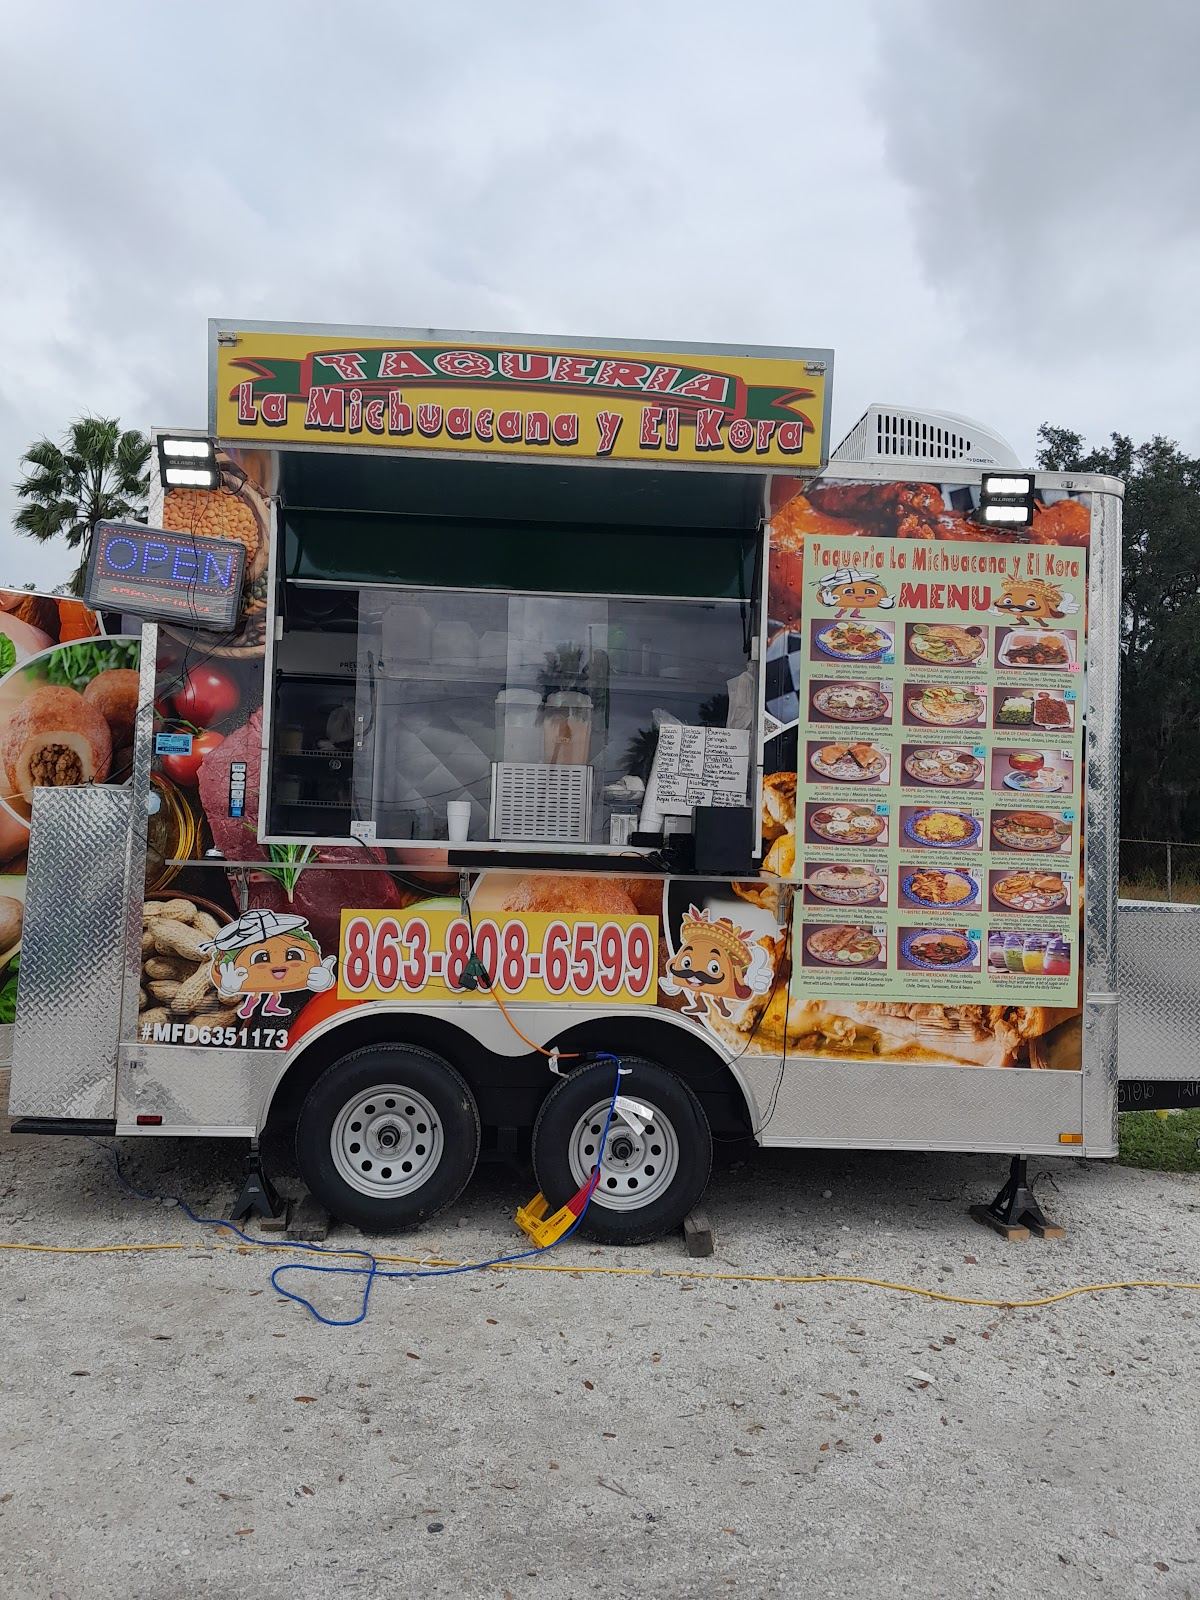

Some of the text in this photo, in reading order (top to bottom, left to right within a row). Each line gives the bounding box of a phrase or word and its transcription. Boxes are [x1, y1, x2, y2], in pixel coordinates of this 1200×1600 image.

[314, 350, 730, 404] TAQUERIA
[238, 383, 804, 454] La Michuacana y El Kora
[105, 538, 232, 587] OPEN
[813, 544, 1080, 577] Taqueria La Michuacana y El Kora
[898, 582, 991, 611] MENU
[344, 915, 654, 997] 863-808-6599
[141, 1022, 288, 1048] #MFD6351173
